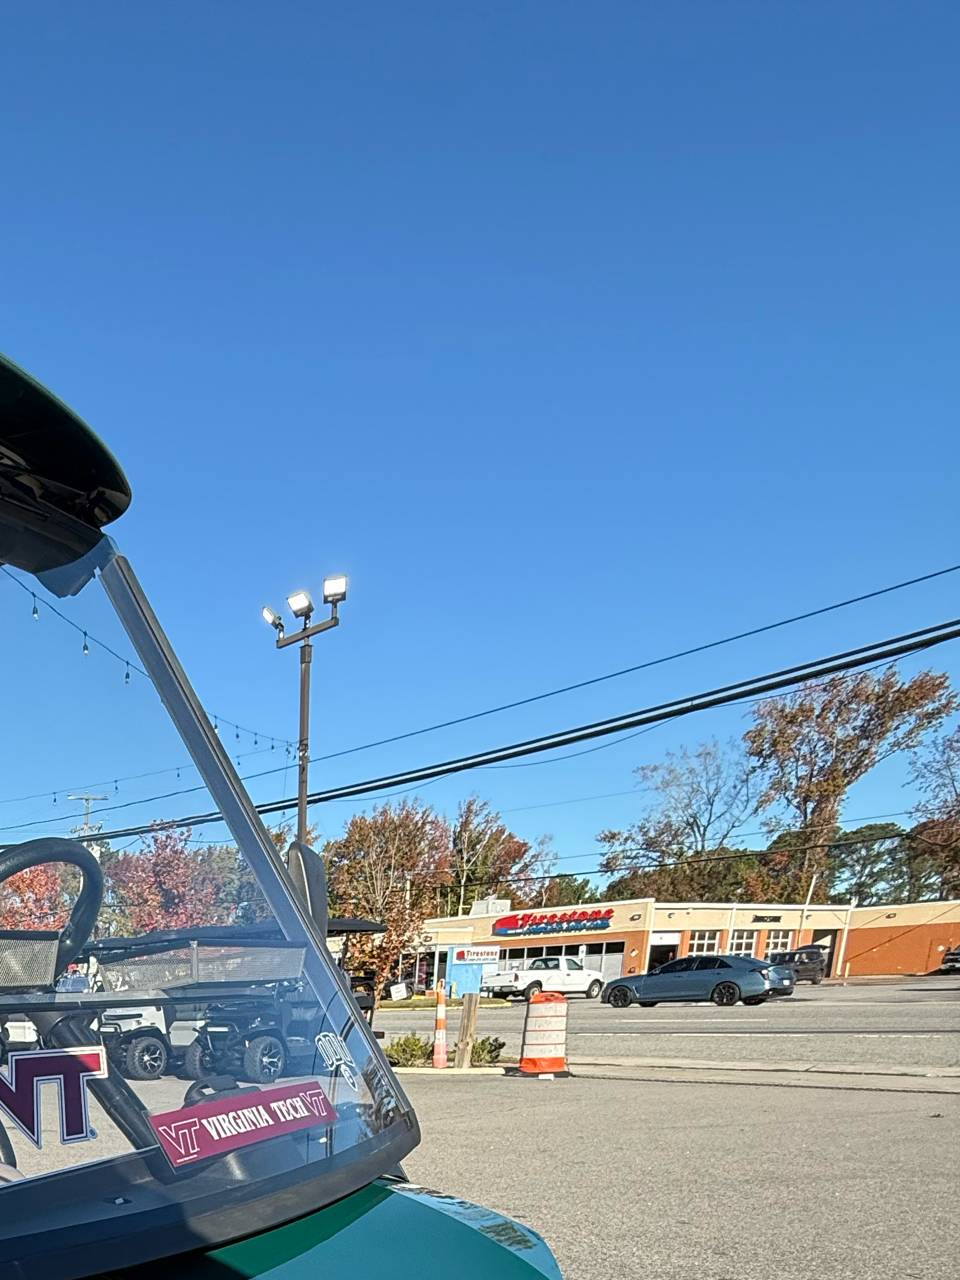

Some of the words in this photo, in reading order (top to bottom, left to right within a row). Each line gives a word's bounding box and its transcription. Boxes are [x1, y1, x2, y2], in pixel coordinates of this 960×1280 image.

[520, 908, 614, 928] Firestone
[466, 950, 498, 958] Firestone
[158, 1118, 200, 1156] VT
[201, 1105, 274, 1141] VIRGINIA
[270, 1098, 311, 1123] TECH
[299, 1089, 326, 1117] VT
